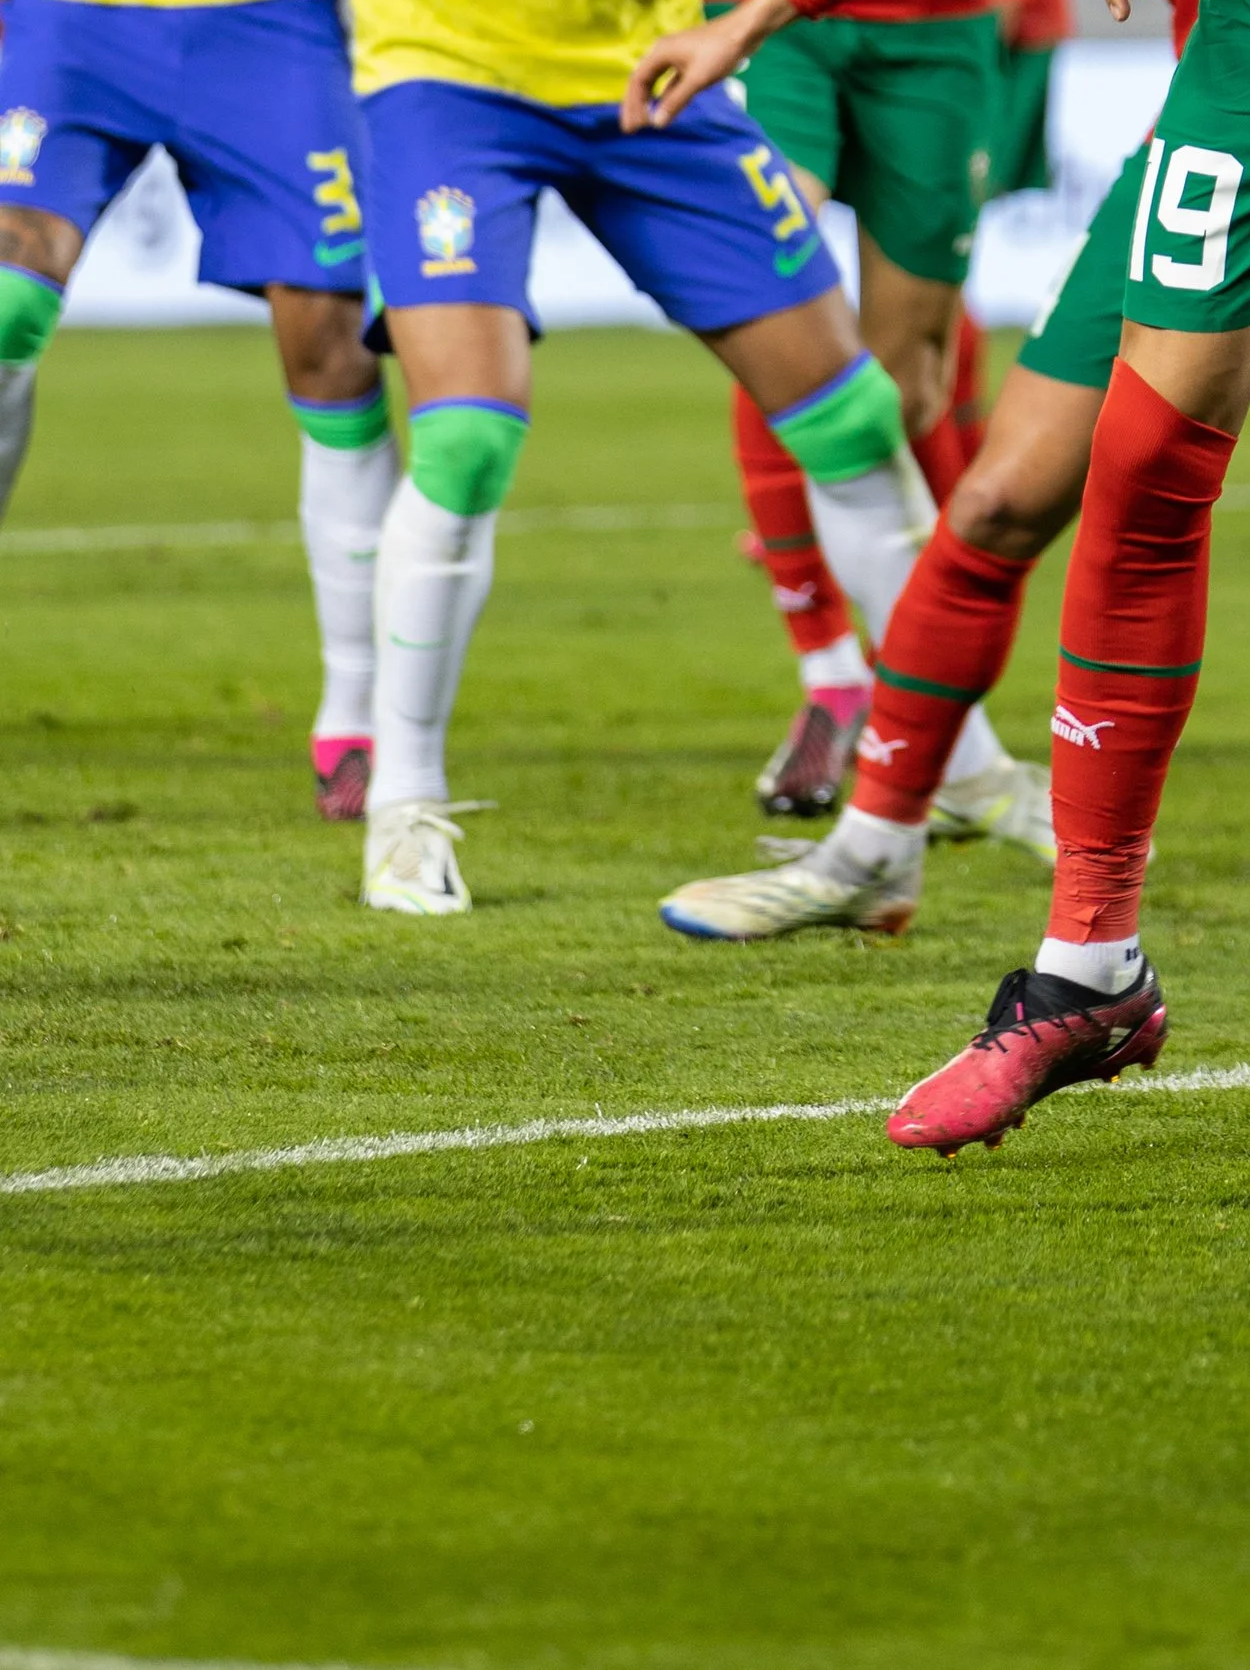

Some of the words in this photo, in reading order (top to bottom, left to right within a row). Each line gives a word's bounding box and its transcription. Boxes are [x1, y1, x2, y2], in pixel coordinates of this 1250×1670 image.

[307, 149, 362, 236] 3
[739, 145, 809, 241] 5
[1128, 138, 1244, 291] 19
